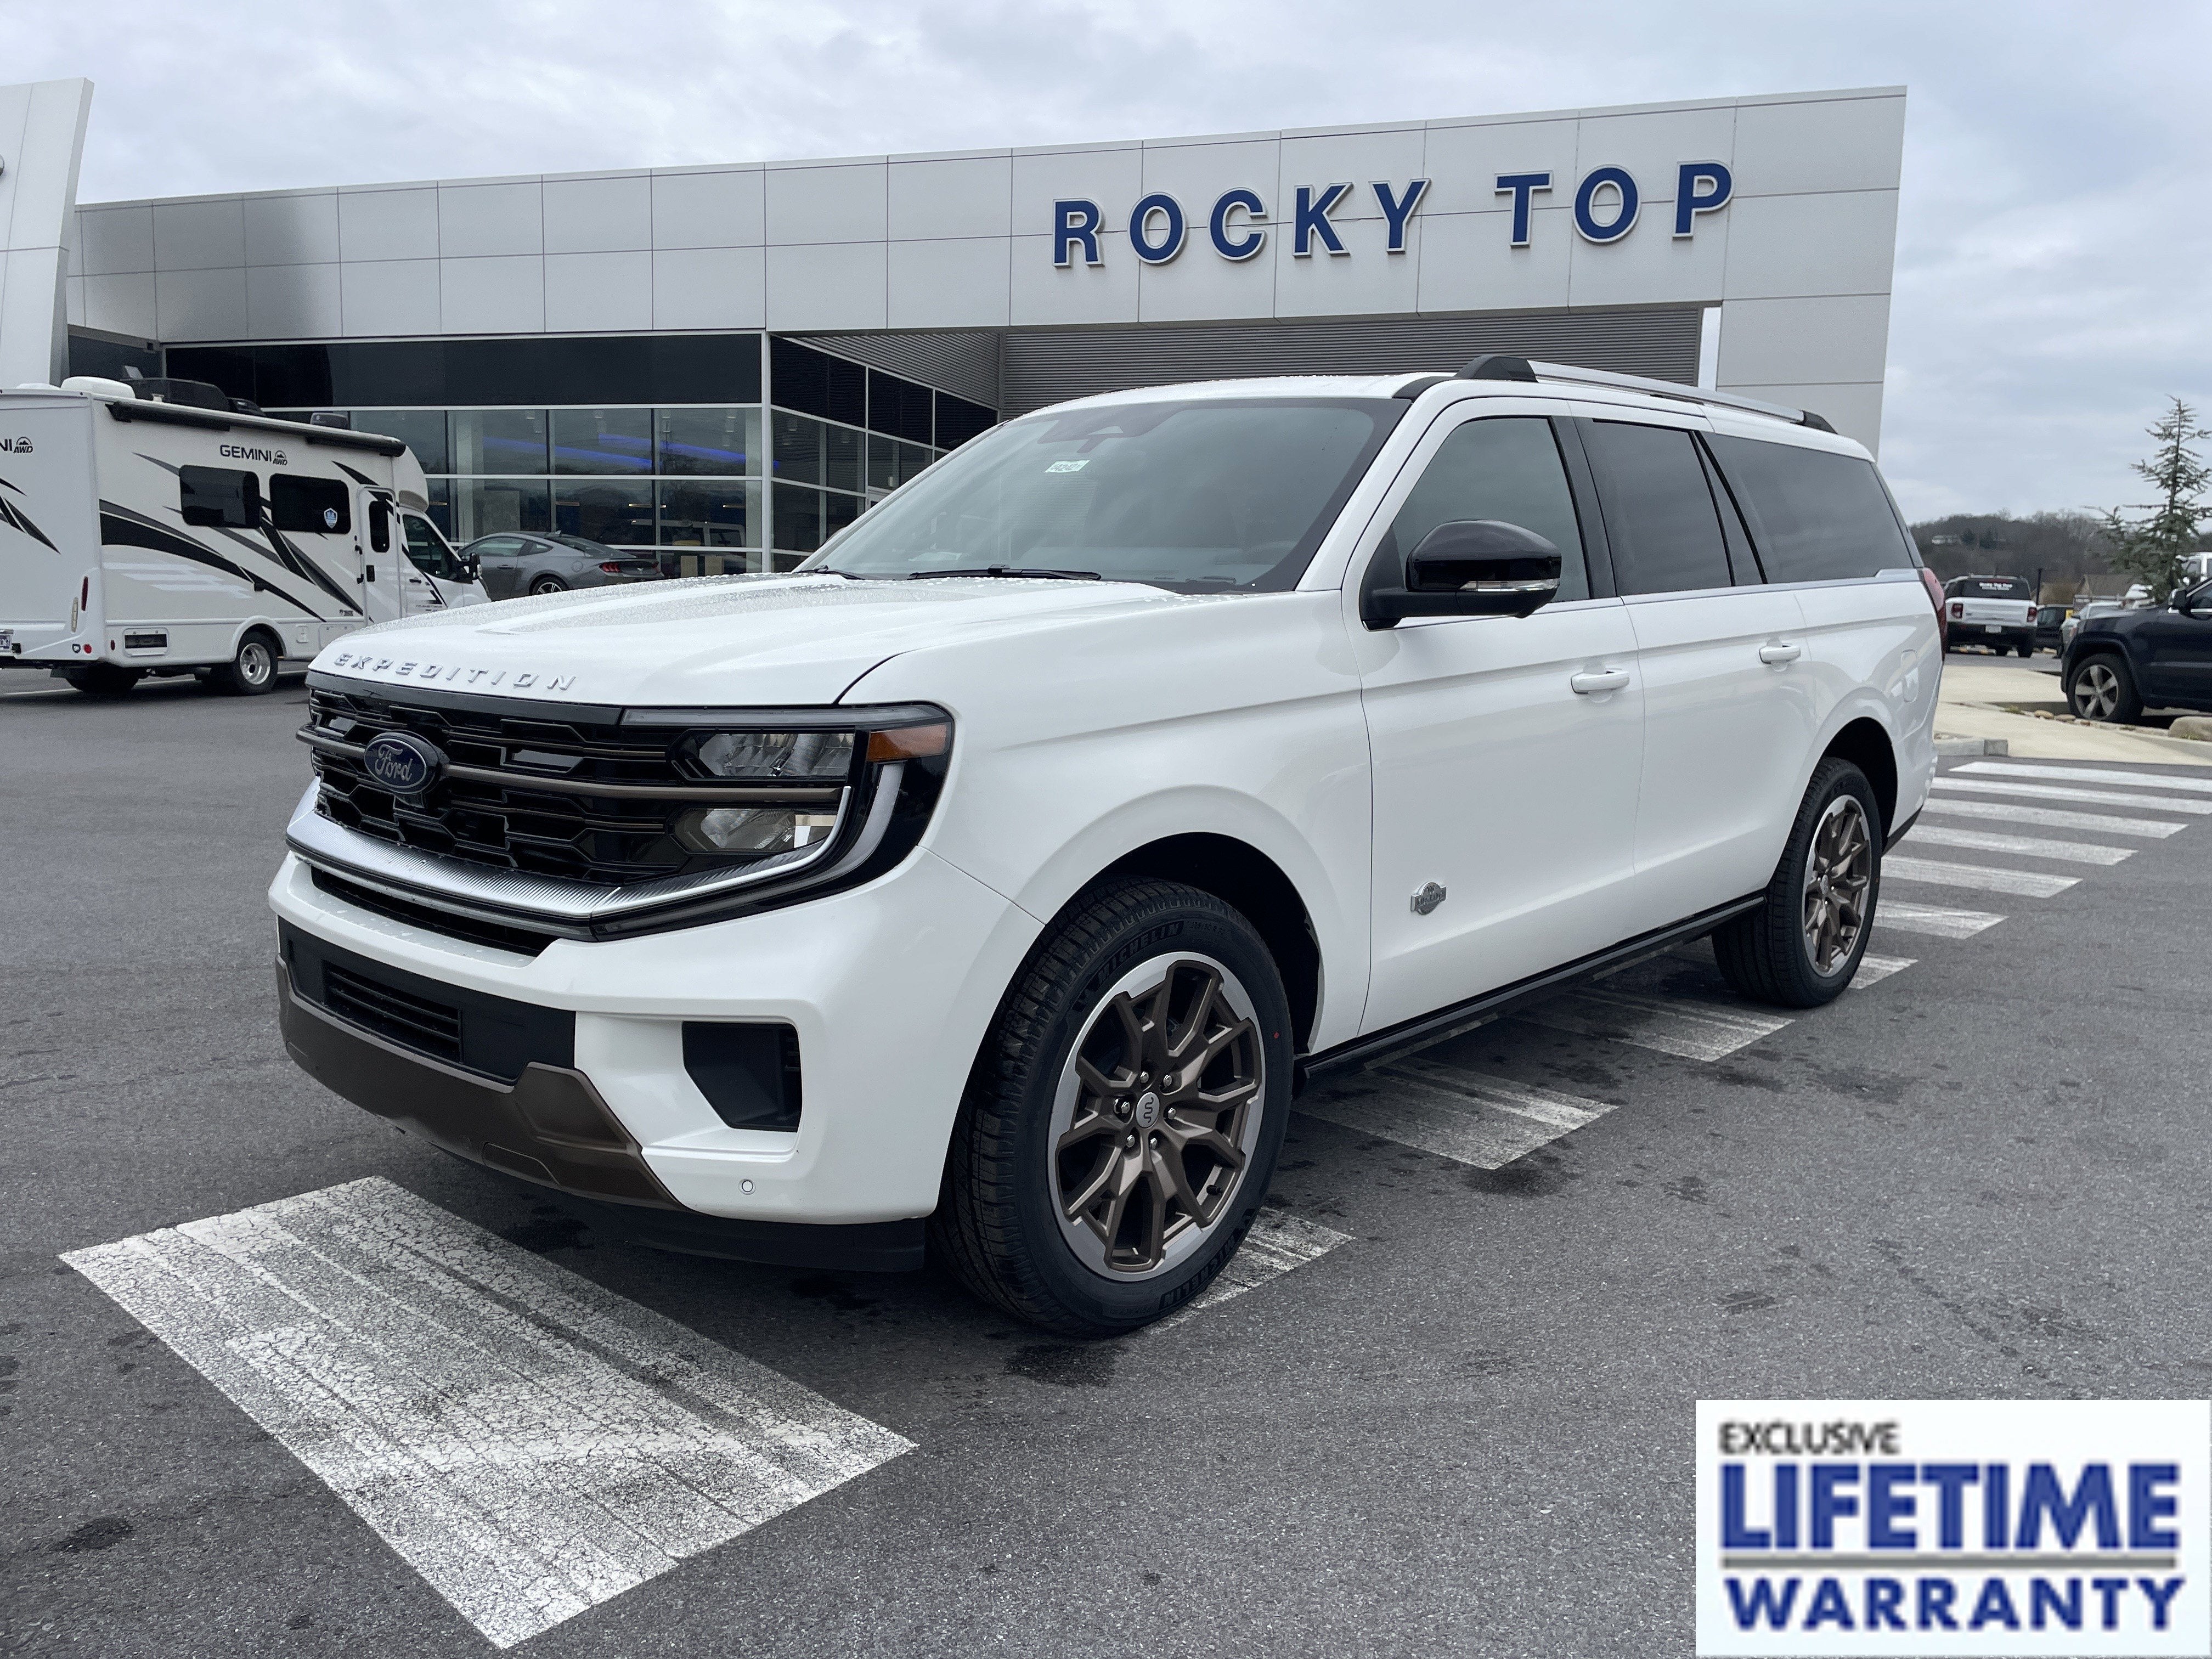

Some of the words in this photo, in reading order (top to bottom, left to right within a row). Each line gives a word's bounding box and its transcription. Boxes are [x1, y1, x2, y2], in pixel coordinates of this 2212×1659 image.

[1052, 177, 1431, 267] ROCKY
[1494, 160, 1734, 247] TOP
[220, 444, 272, 462] GEMINI
[334, 652, 576, 691] EXPEDITION
[375, 744, 413, 782] Ford
[1097, 922, 1180, 985] MICHELIN
[1164, 1234, 1238, 1306] MICHELIN
